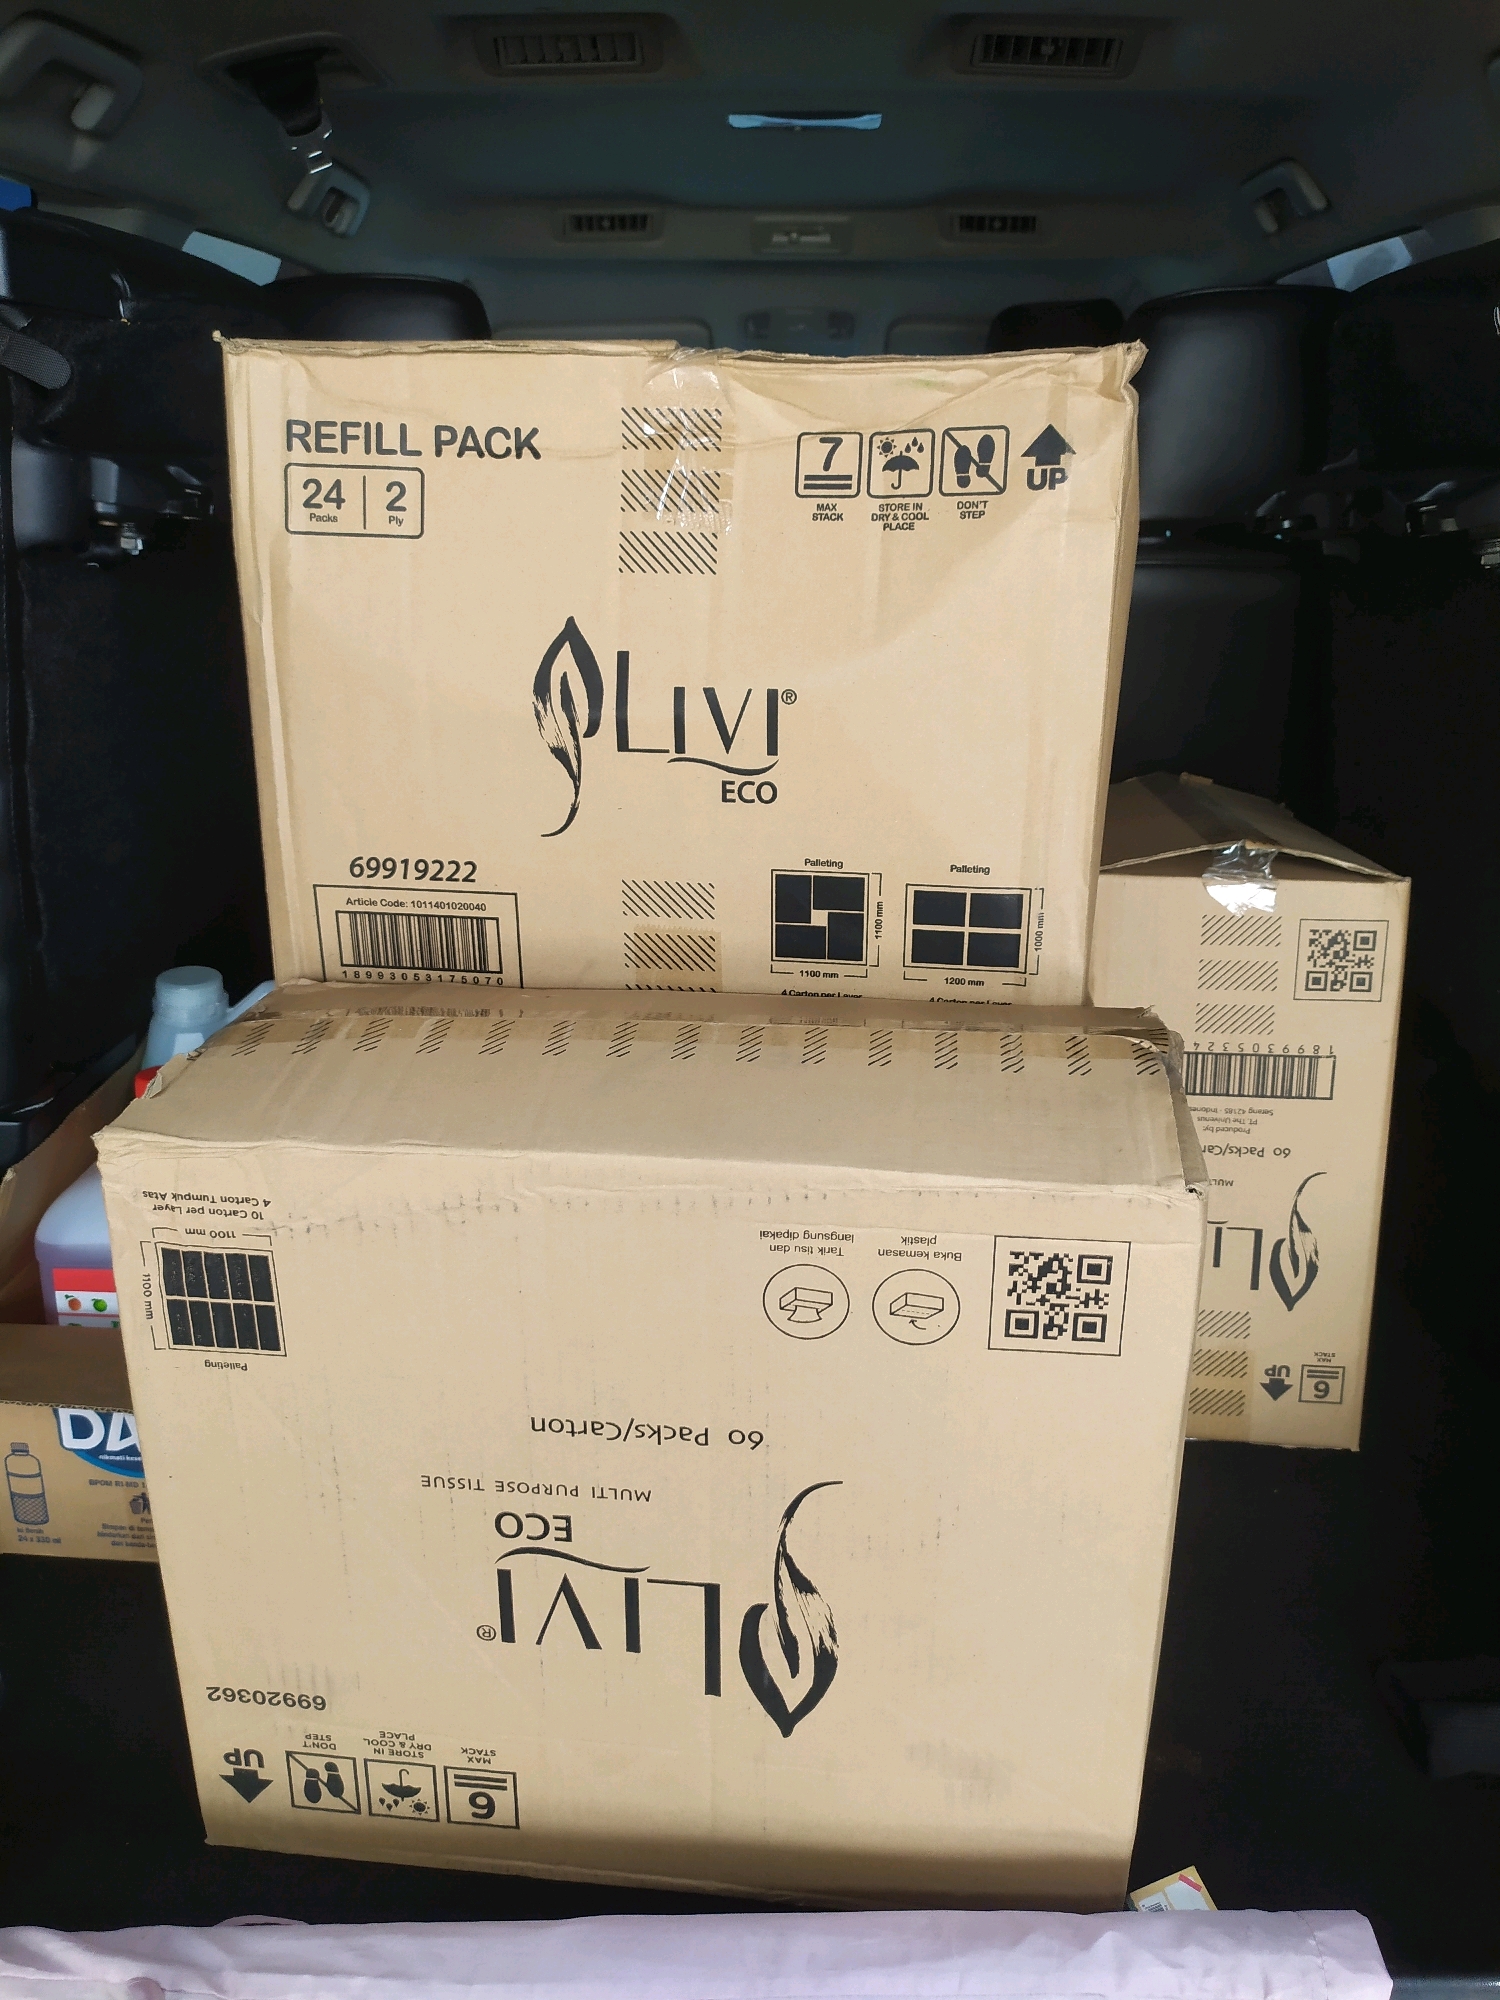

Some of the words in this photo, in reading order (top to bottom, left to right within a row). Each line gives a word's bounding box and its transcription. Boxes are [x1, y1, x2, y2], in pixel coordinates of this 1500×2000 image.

[286, 419, 422, 456] REFILL
[435, 425, 541, 460] PACK
[819, 437, 843, 471] 7
[1027, 468, 1069, 490] UP
[303, 478, 346, 510] 24
[386, 481, 407, 512] 2
[816, 503, 837, 512] MAX
[878, 503, 910, 512] STORE
[912, 503, 923, 511] IN
[957, 501, 988, 510] DON'T
[310, 513, 338, 523] Packs
[812, 512, 844, 522] STACK
[871, 513, 891, 522] DRY
[892, 513, 899, 521] &
[901, 512, 929, 521] COOL
[960, 511, 985, 519] STEP
[389, 516, 404, 526] Ply
[883, 522, 915, 531] PLACE
[721, 780, 778, 804] ECO
[350, 856, 478, 883] 69919222
[804, 859, 844, 869] Palleting
[950, 865, 990, 875] Palleting
[346, 898, 378, 907] Article
[380, 899, 408, 908] Code:
[411, 900, 486, 911] 1011401020040
[876, 901, 883, 918] mm
[1037, 911, 1044, 928] mm
[1035, 929, 1043, 951] 1000
[944, 978, 966, 986] 1200
[1216, 1126, 1250, 1134] Produced
[143, 1190, 167, 1200] Atas
[171, 1192, 216, 1203] Tumpuk
[220, 1196, 259, 1207] Carton
[263, 1198, 271, 1207] 4
[152, 1204, 182, 1215] Layer
[186, 1206, 205, 1215] per
[208, 1208, 248, 1219] Carton
[251, 1211, 264, 1220] 10
[185, 1228, 206, 1236] mm
[210, 1230, 236, 1239] 1100
[760, 1230, 800, 1241] dipakai
[803, 1231, 854, 1244] langsung
[901, 1235, 937, 1246] plastik
[770, 1244, 790, 1253] dan
[794, 1245, 814, 1255] tisu
[818, 1245, 844, 1257] Tarik
[878, 1248, 930, 1260] kemasan
[933, 1252, 962, 1262] Buka
[142, 1273, 153, 1298] 1100
[145, 1301, 154, 1320] mm
[204, 1359, 248, 1371] Palleting
[1264, 1364, 1291, 1378] UP
[1314, 1380, 1330, 1399] 6
[530, 1416, 709, 1446] Packs/Carton
[728, 1428, 764, 1450] 60
[420, 1475, 485, 1491] TISSUE
[495, 1480, 579, 1498] PURPOSE
[591, 1487, 652, 1502] MULTI
[494, 1511, 573, 1543] ECO
[205, 1686, 327, 1711] 69920362
[305, 1733, 332, 1741] STEP
[379, 1730, 415, 1741] PLACE
[303, 1741, 337, 1750] DON'T
[363, 1738, 396, 1748] COOL
[399, 1741, 406, 1749] &
[409, 1742, 432, 1751] DRY
[388, 1749, 424, 1758] STORE
[460, 1747, 496, 1756] STACK
[223, 1748, 265, 1768] UP
[467, 1755, 492, 1765] MAX
[468, 1792, 496, 1820] 6
